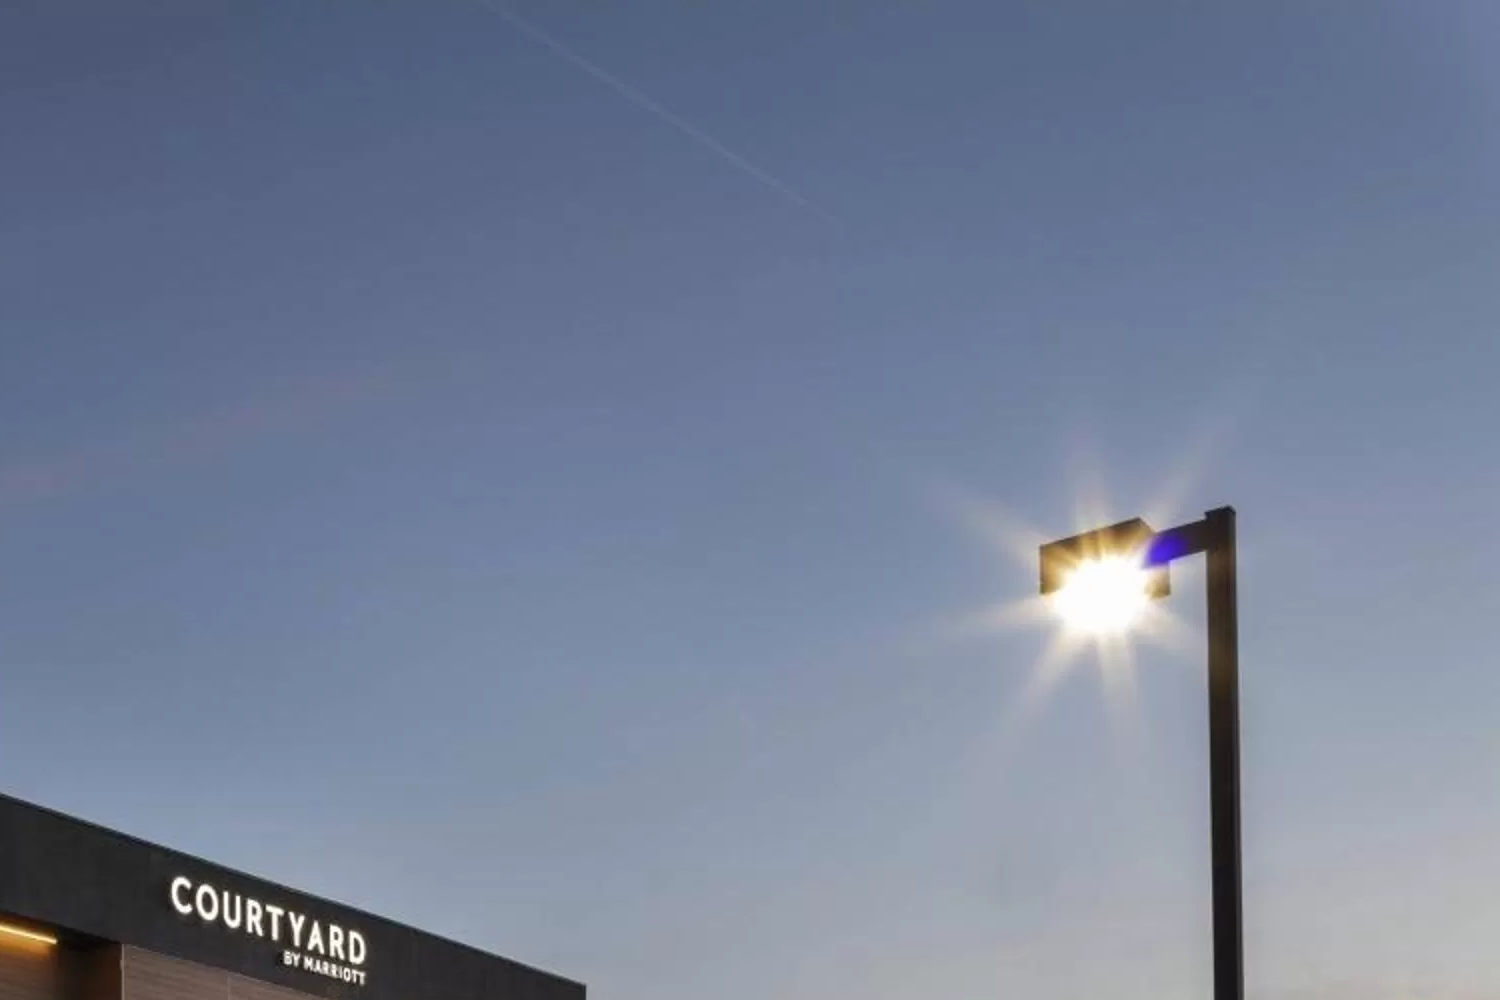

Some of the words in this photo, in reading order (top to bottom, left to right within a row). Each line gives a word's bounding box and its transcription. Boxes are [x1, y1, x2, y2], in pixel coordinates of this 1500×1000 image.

[171, 876, 366, 965] COURTYARD
[283, 951, 300, 968] BY
[303, 956, 366, 986] MARRIOTT
